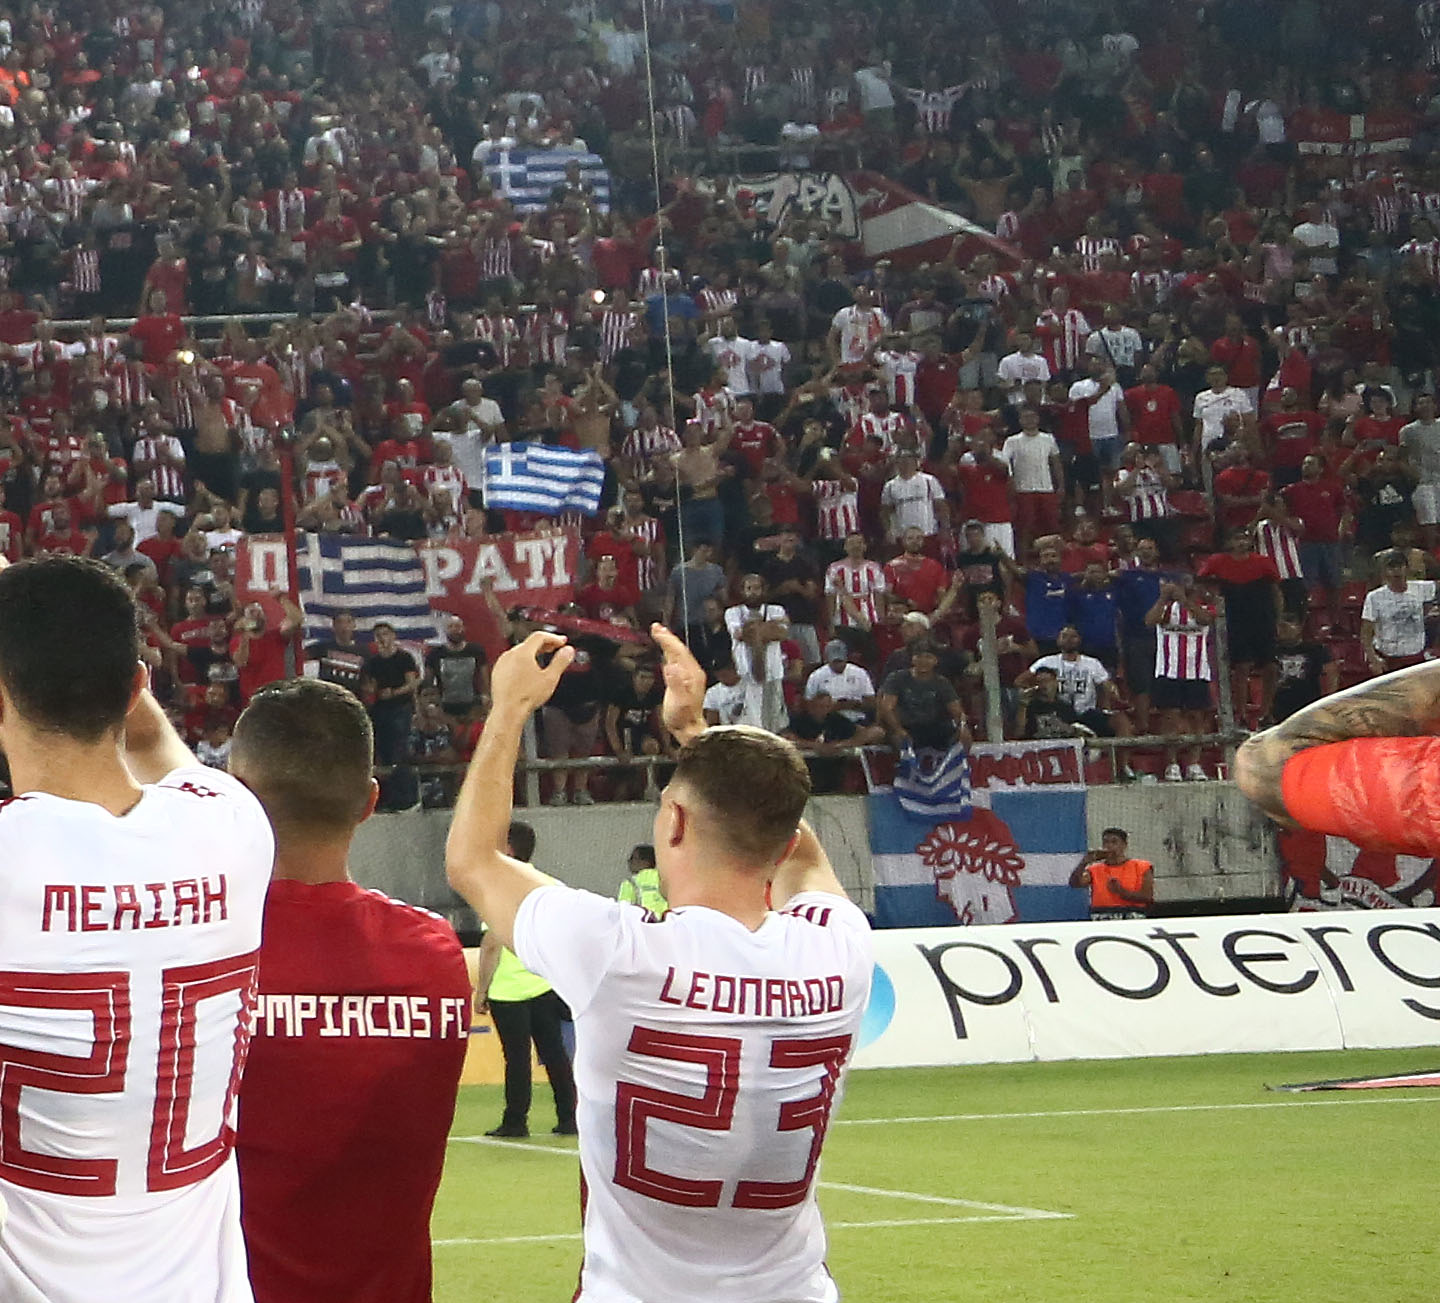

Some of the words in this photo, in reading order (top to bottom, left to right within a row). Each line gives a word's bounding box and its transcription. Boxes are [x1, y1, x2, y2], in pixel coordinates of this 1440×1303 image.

[42, 874, 228, 934] MERIAH
[440, 997, 469, 1040] FC
[659, 967, 846, 1020] LEONARDO
[612, 1025, 853, 1211] 23
